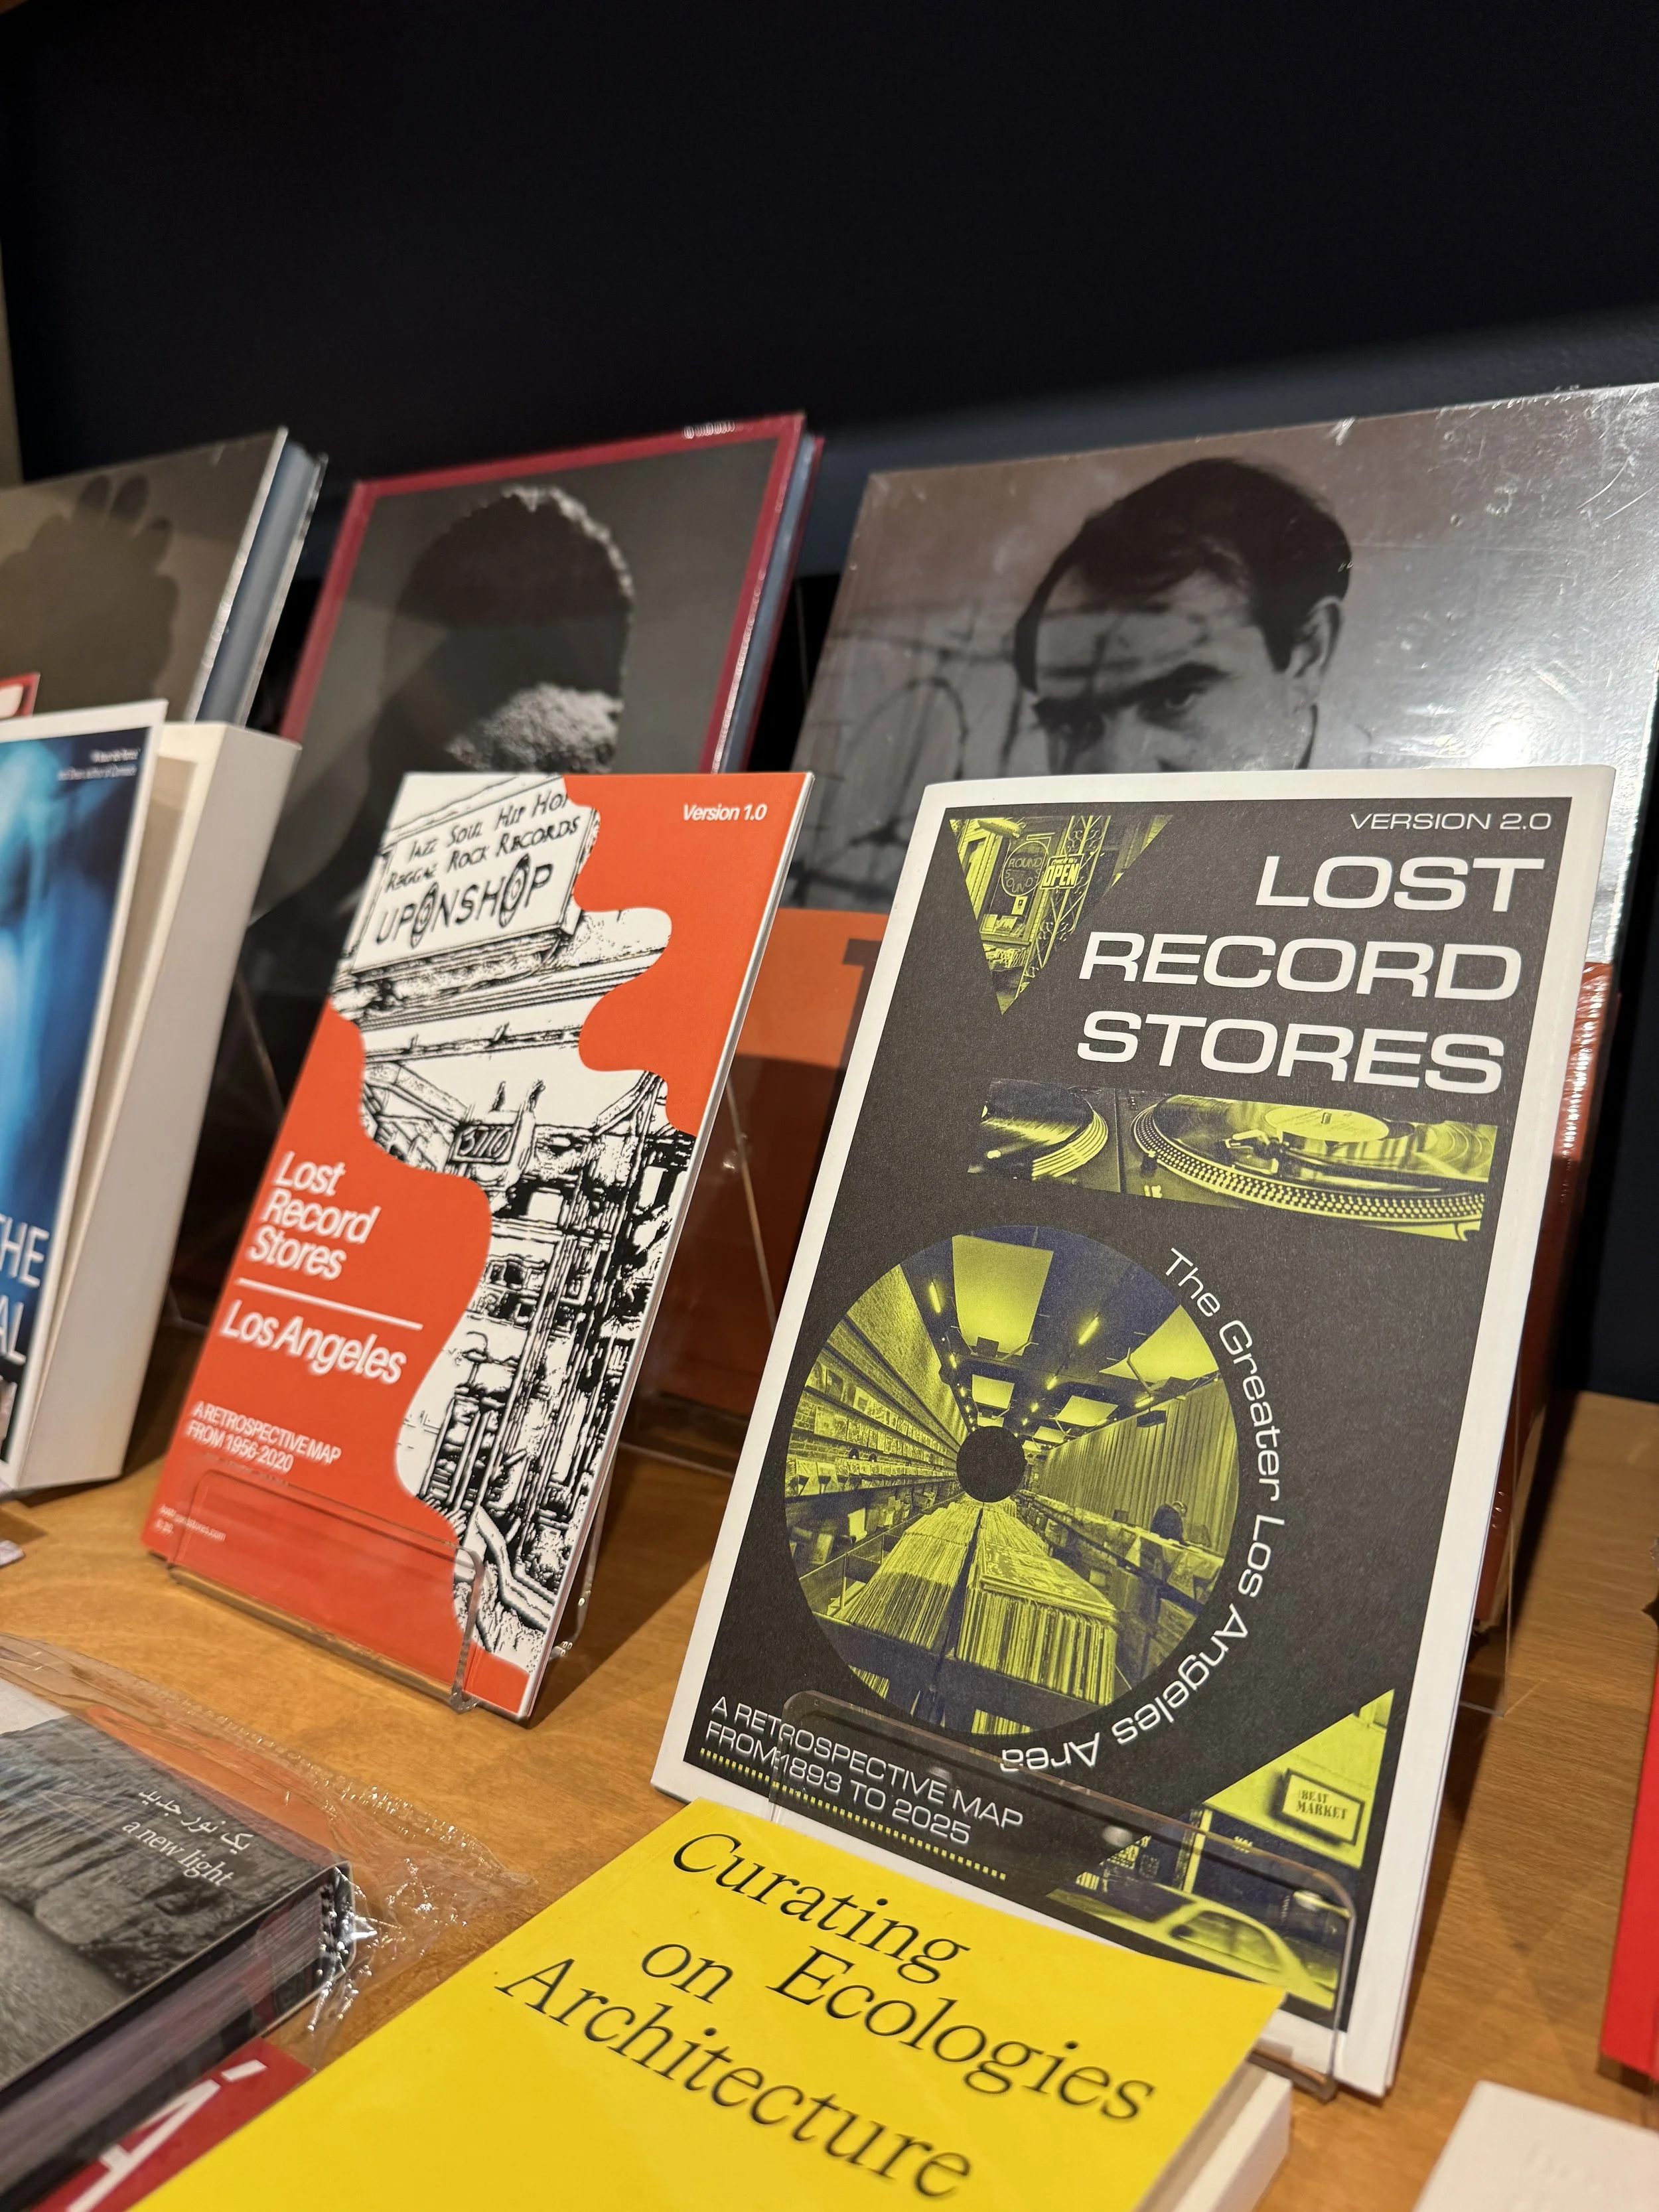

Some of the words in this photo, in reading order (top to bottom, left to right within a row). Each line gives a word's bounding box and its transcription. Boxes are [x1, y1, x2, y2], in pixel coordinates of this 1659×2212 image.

[446, 845, 490, 873] ROCK
[495, 816, 581, 857] RECORDS
[683, 804, 739, 822] Version
[742, 804, 768, 821] 1.0
[1350, 813, 1491, 830] VERSION
[1500, 812, 1551, 830] 2.0
[1007, 857, 1042, 867] ROUND
[1041, 863, 1080, 887] OPEN
[1255, 855, 1546, 912] LOST
[1078, 930, 1522, 1001] RECORD
[1077, 1010, 1504, 1095] STORES
[273, 1150, 346, 1196] Lost
[262, 1187, 381, 1244] Record
[247, 1225, 346, 1280] Stores
[1165, 1247, 1221, 1317] The
[220, 1299, 279, 1348] Los
[271, 1315, 407, 1384] Angeles
[192, 1401, 204, 1418] A
[204, 1403, 309, 1455] RETROSPECTIVE
[306, 1439, 342, 1465] MAP
[1218, 1319, 1281, 1502] Greater
[186, 1419, 226, 1448] FROM
[224, 1433, 295, 1474] 1956-2020
[1238, 1514, 1285, 1598] Los
[1112, 1603, 1248, 1745] Angeles
[706, 1720, 778, 1767] FROM
[780, 1753, 843, 1795] 1893
[850, 1779, 887, 1811] TO
[892, 1799, 972, 1846] 2025
[711, 1696, 727, 1719] A
[735, 1703, 948, 1808] RETROSPECTIVE
[952, 1789, 1023, 1830] MAP
[999, 1732, 1100, 1773] Area
[1296, 1801, 1348, 1819] MARKET
[1299, 1790, 1328, 1803] BEAT
[122, 1821, 141, 1834] a
[136, 1828, 185, 1856] new
[178, 1849, 234, 1887] light
[673, 1832, 970, 1984] Curating
[640, 1942, 733, 2004] on
[766, 1945, 1156, 2122] Ecologies
[495, 1958, 972, 2198] Architecture
